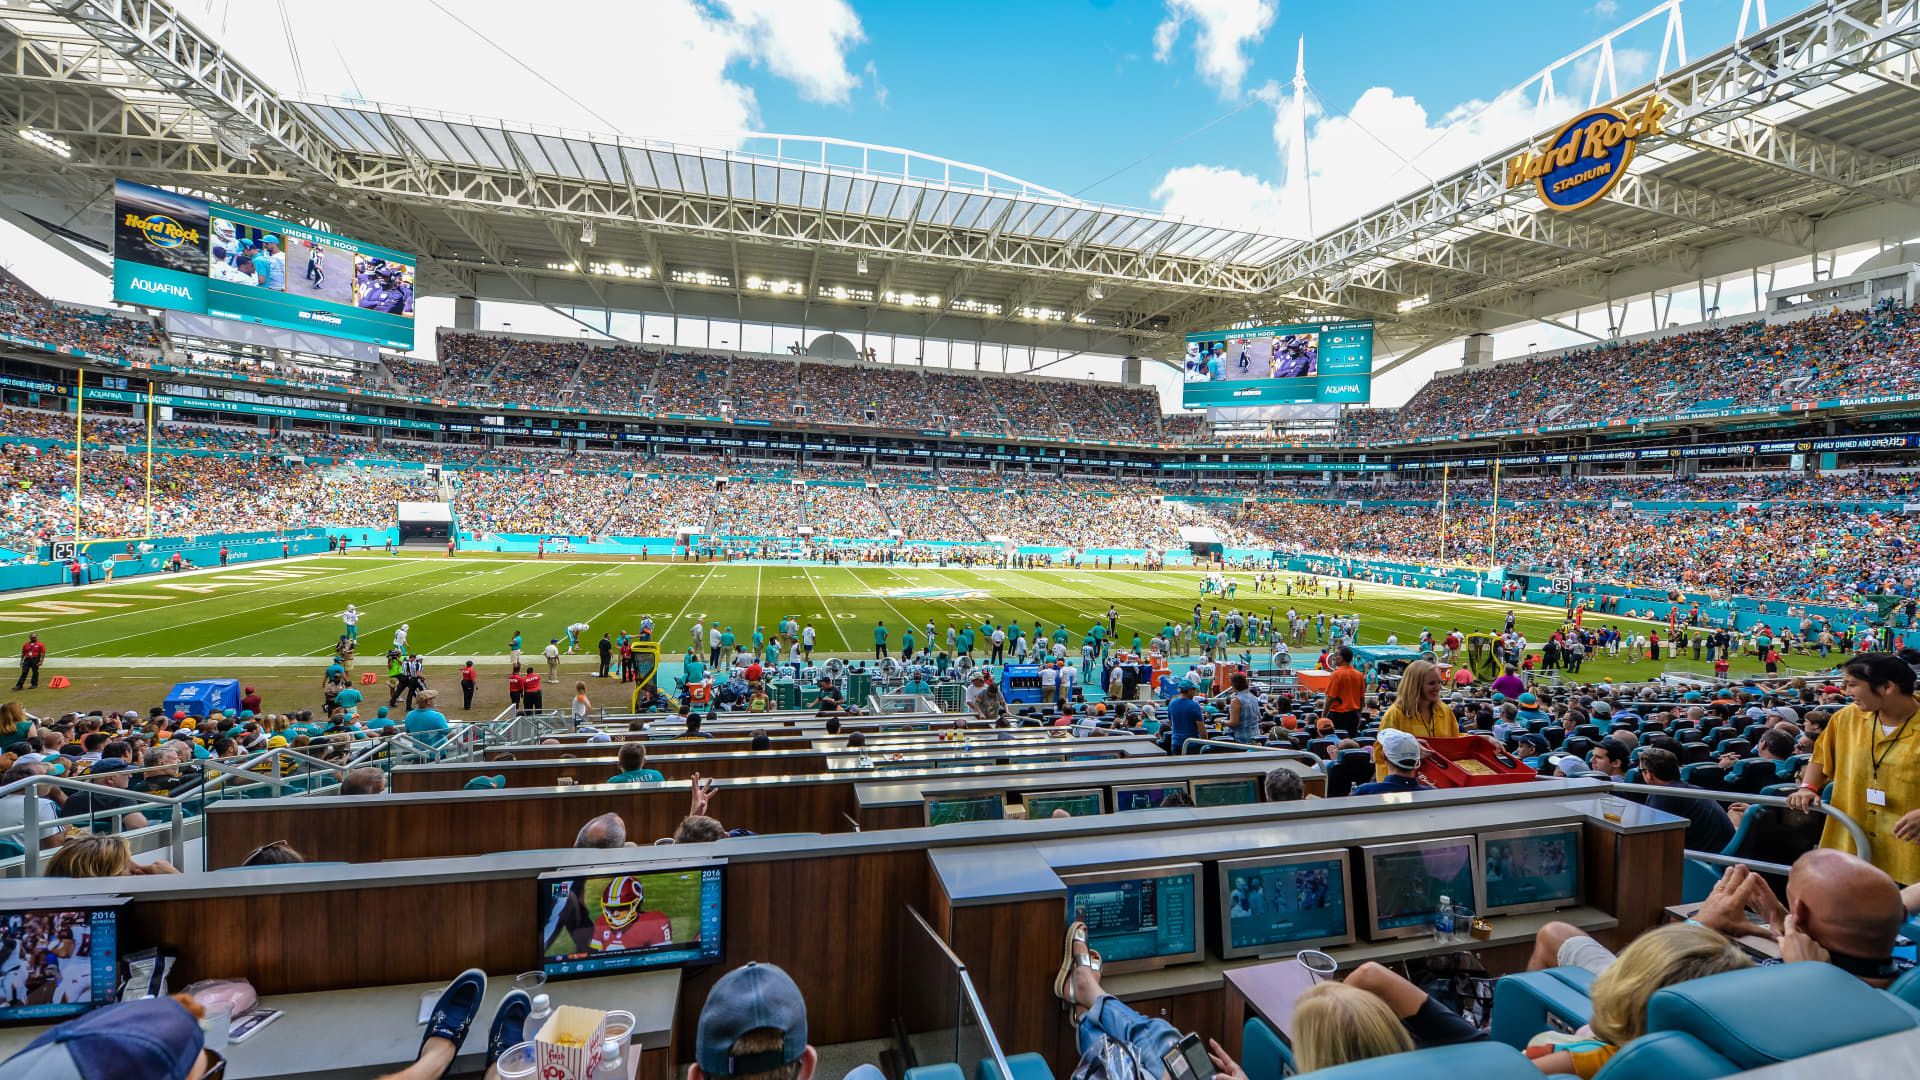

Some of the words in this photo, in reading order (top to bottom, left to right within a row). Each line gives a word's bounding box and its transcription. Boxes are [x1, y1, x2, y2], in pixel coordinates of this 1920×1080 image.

[1506, 128, 1583, 189] Hard
[1581, 94, 1668, 158] Rock
[1553, 162, 1612, 193] STADIUM
[124, 213, 164, 231] Hard
[164, 223, 200, 244] Rock
[282, 227, 313, 241] UNDER
[315, 235, 331, 245] THE
[333, 240, 359, 252] HOOD
[130, 277, 192, 300] AQUAFINA
[89, 390, 124, 400] AQUAFINA
[1325, 384, 1360, 395] AQUAFINA
[1840, 398, 1867, 406] MARK
[1870, 395, 1903, 404] DUPER
[1906, 392, 1920, 401] 85
[1692, 412, 1719, 420] MARINO
[1879, 411, 1920, 420] BOKAM
[1813, 441, 1834, 449] FAMILY
[1835, 440, 1857, 448] OWNED
[1857, 439, 1871, 447] AND
[56, 542, 73, 558] 25
[1554, 579, 1569, 590] 25
[52, 677, 63, 687] 10
[362, 674, 373, 684] 20
[693, 687, 704, 699] G
[702, 869, 721, 877] 2016
[91, 911, 116, 919] 2016
[547, 1050, 565, 1060] fresh
